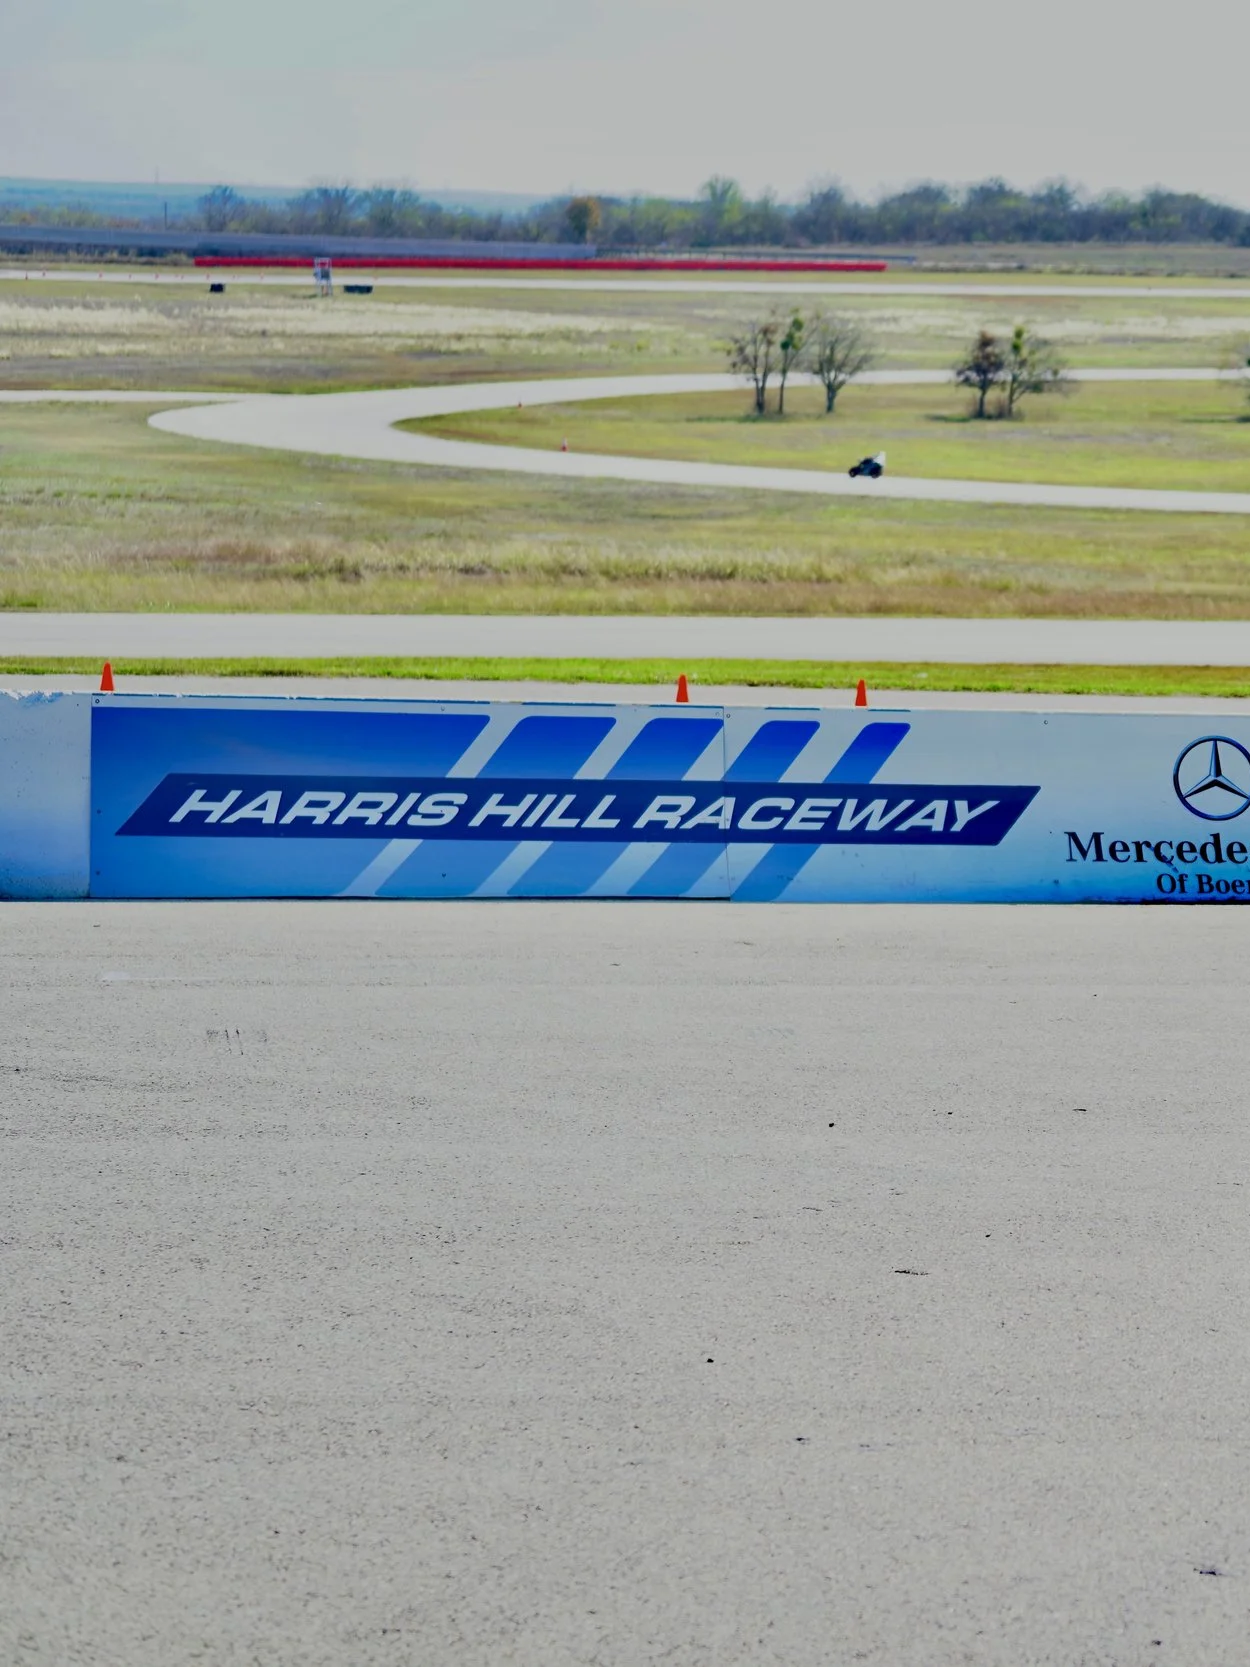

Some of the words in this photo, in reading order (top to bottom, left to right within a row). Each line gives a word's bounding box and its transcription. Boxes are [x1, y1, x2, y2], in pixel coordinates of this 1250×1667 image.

[169, 790, 468, 826] HARRIS
[468, 794, 620, 828] HILL
[633, 795, 999, 831] RACEWAY
[1157, 873, 1189, 894] Of
